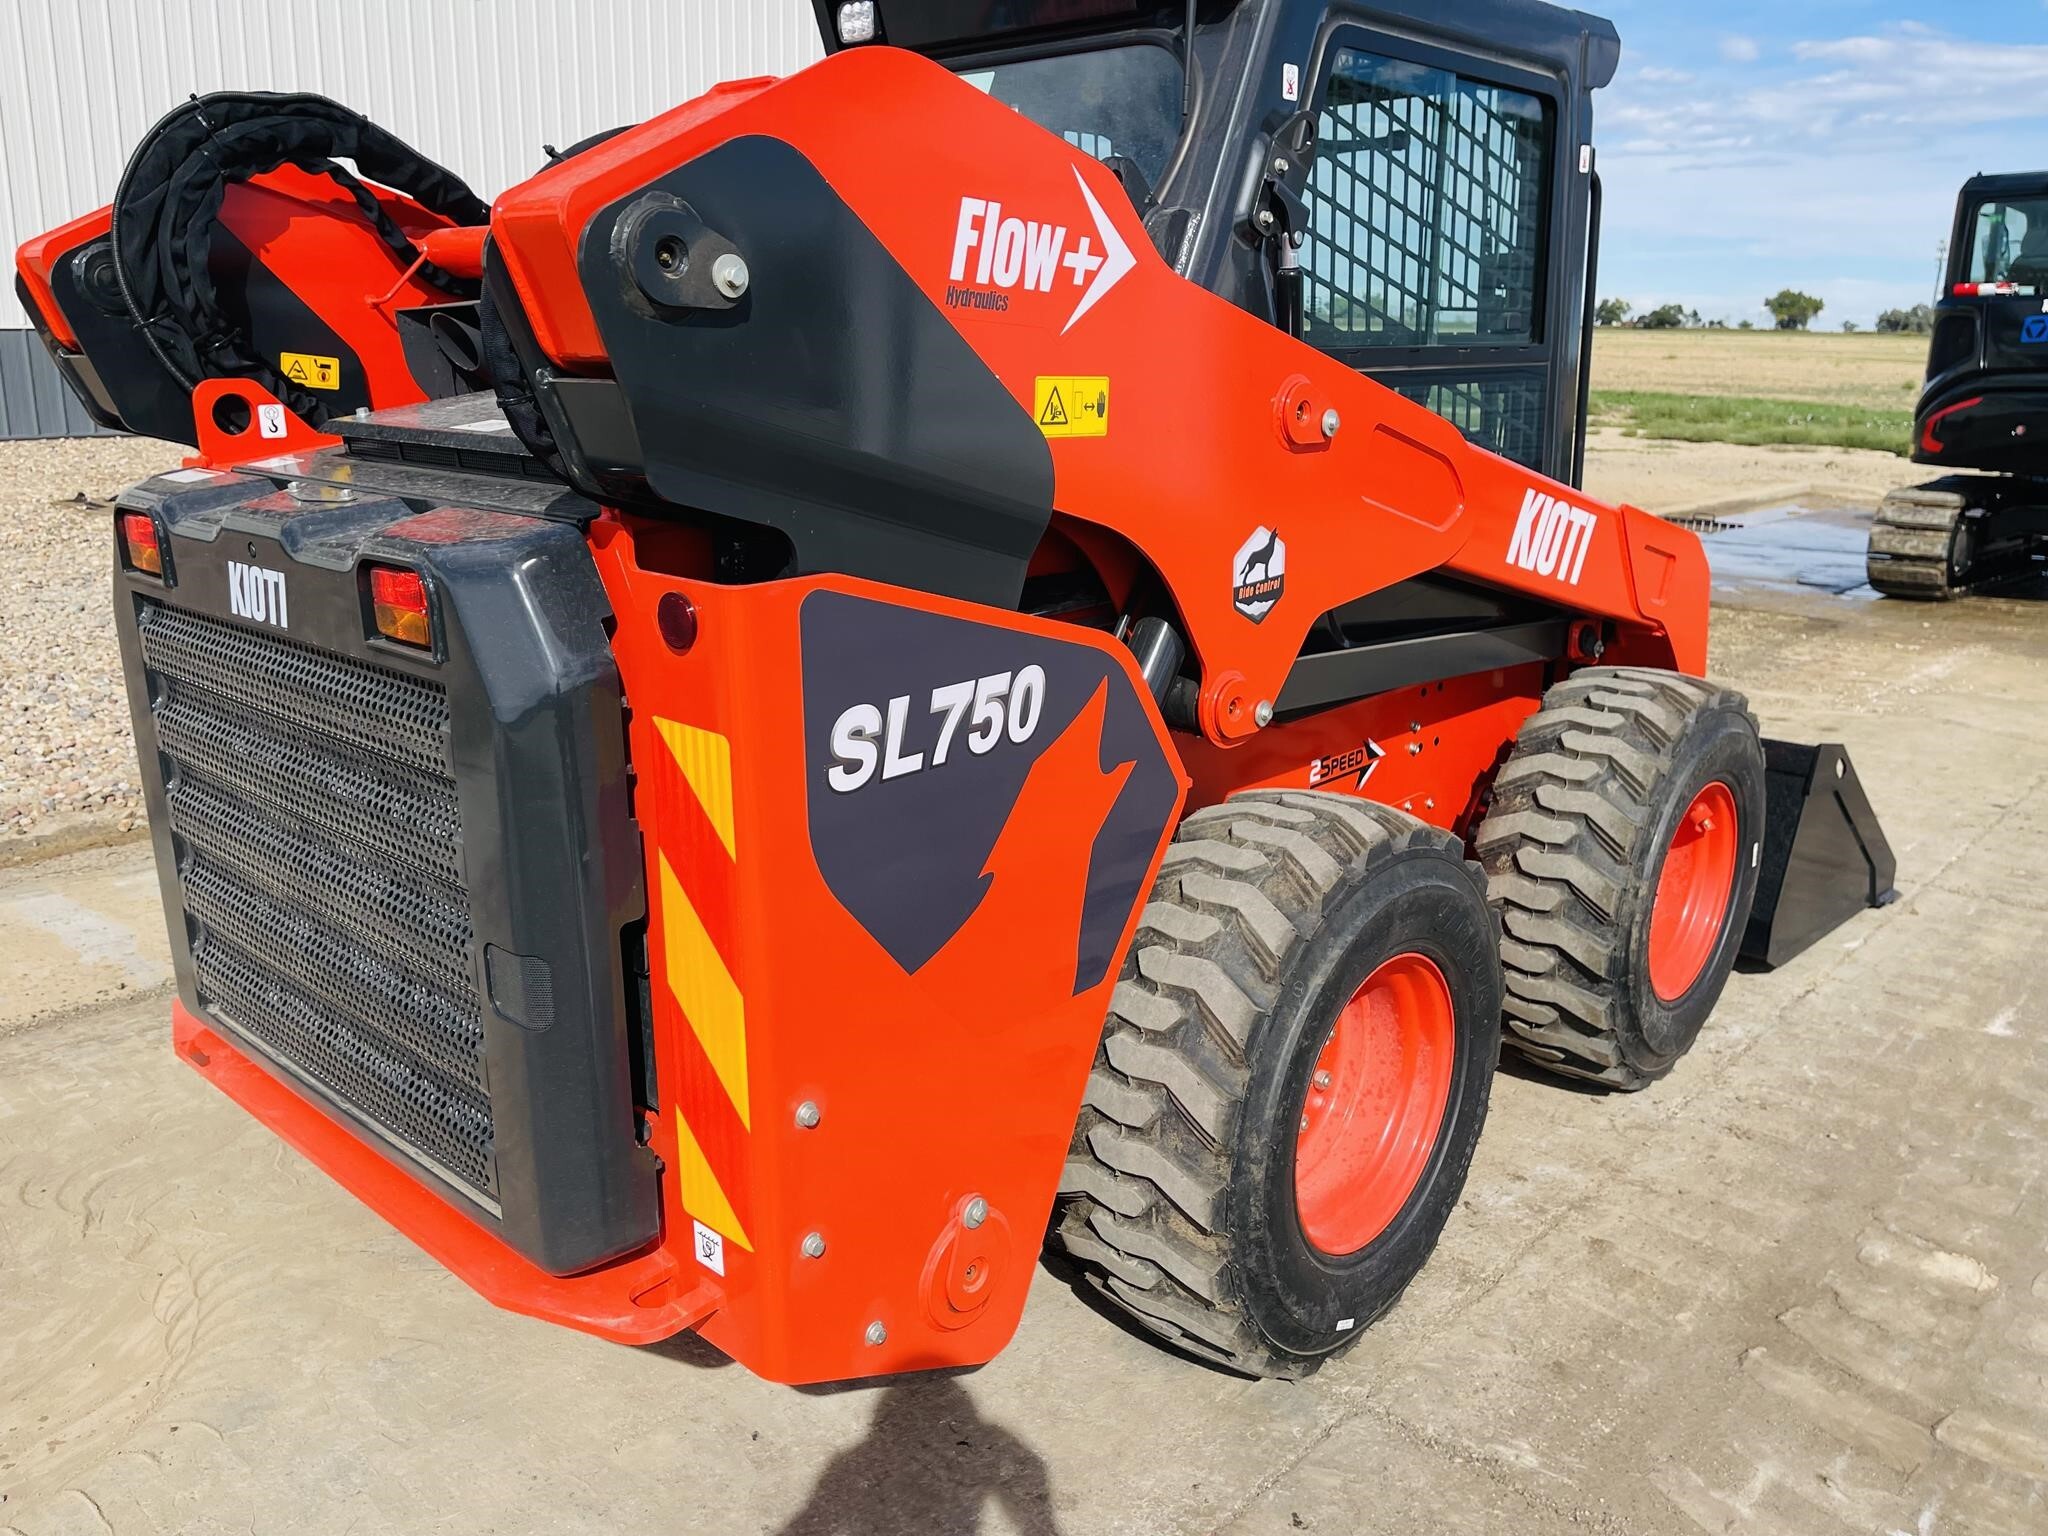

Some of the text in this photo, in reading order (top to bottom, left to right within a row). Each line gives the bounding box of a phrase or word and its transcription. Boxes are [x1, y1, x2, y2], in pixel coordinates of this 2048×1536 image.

[945, 284, 1009, 311] Hydraulics
[1505, 487, 1598, 586] KIOTI
[227, 560, 288, 628] KIOTI
[1239, 577, 1281, 600] Ride Control
[828, 664, 1047, 794] SL750
